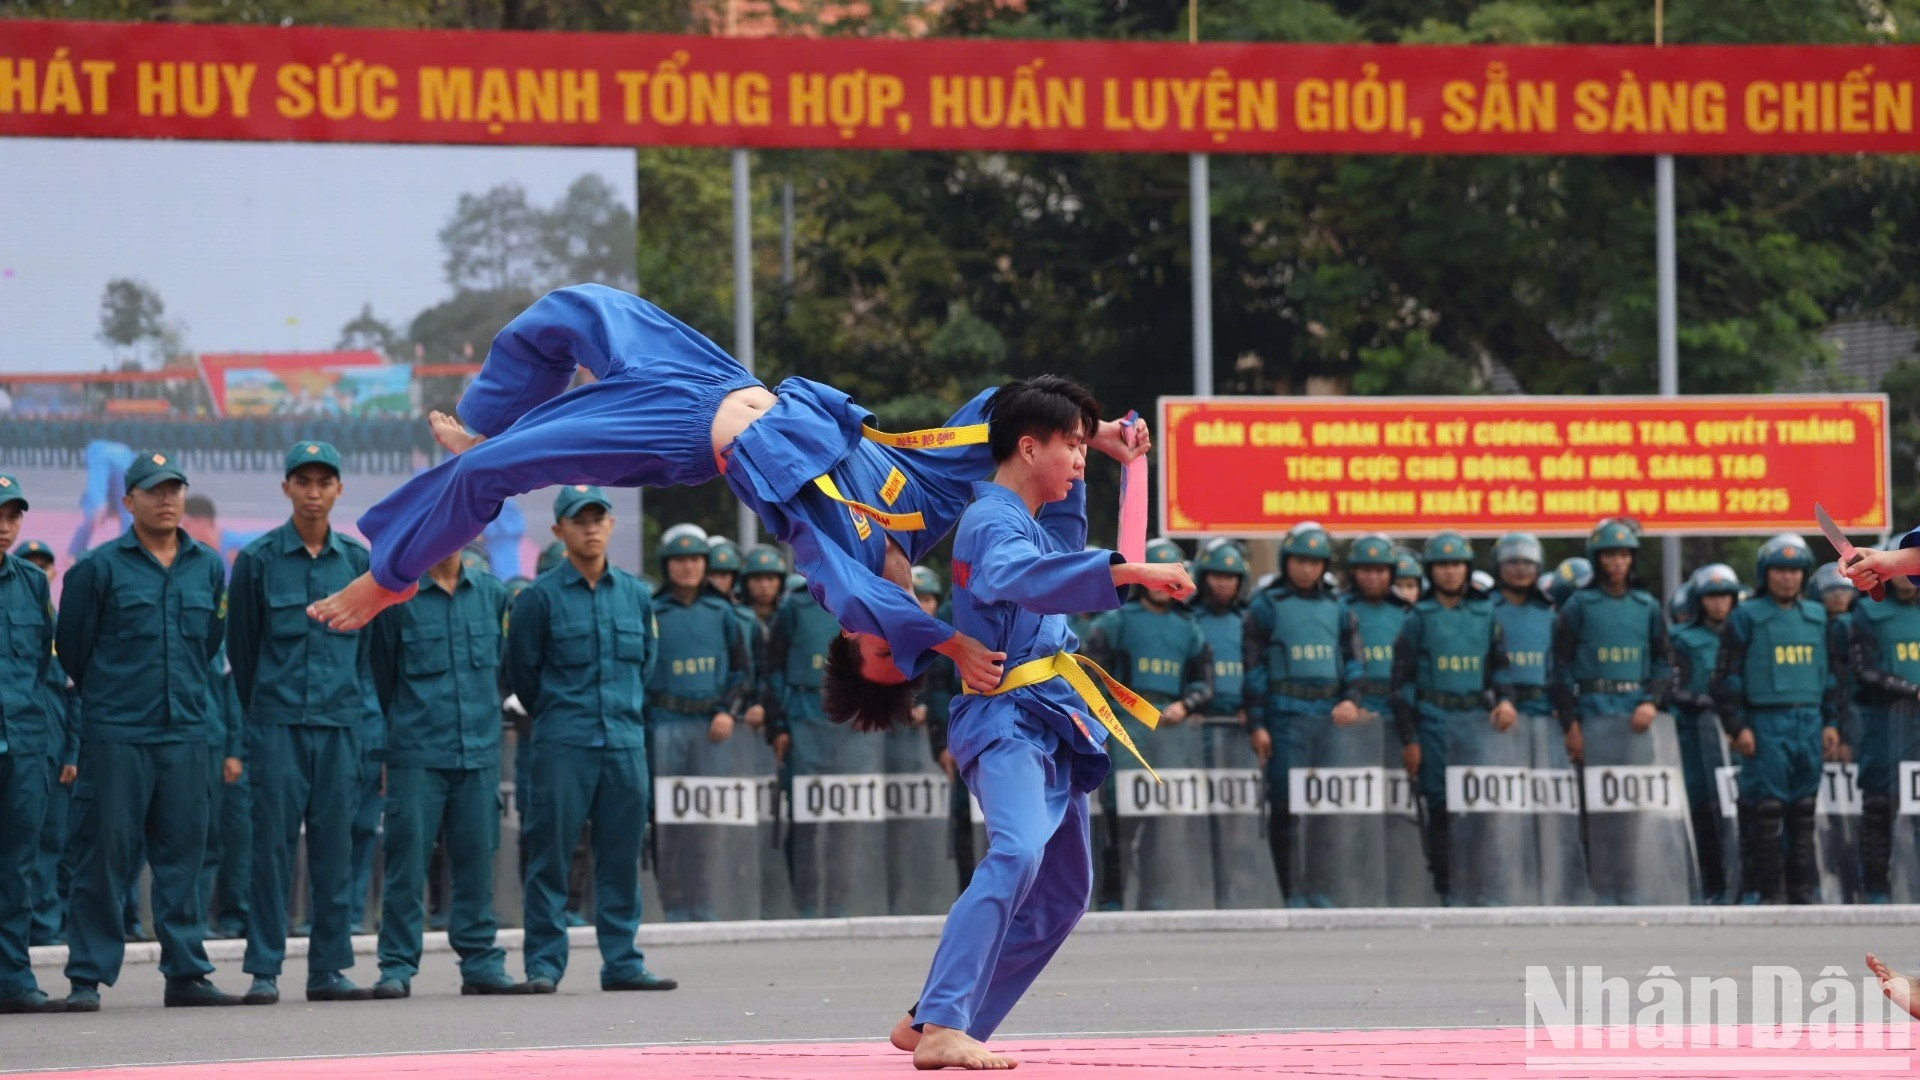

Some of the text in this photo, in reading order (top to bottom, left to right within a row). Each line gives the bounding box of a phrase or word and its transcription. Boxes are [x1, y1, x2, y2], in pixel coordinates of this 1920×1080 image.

[0, 47, 1912, 142] HÁT HUY SỨC MẠNH TỔNG HỢP, HUẤN LUYỆN GIỎI, SẴN SÀNG CHIẾN
[1725, 488, 1790, 513] 2025
[672, 656, 716, 676] DQTT
[1438, 654, 1480, 673] DQTT
[1774, 645, 1814, 666] DQTT
